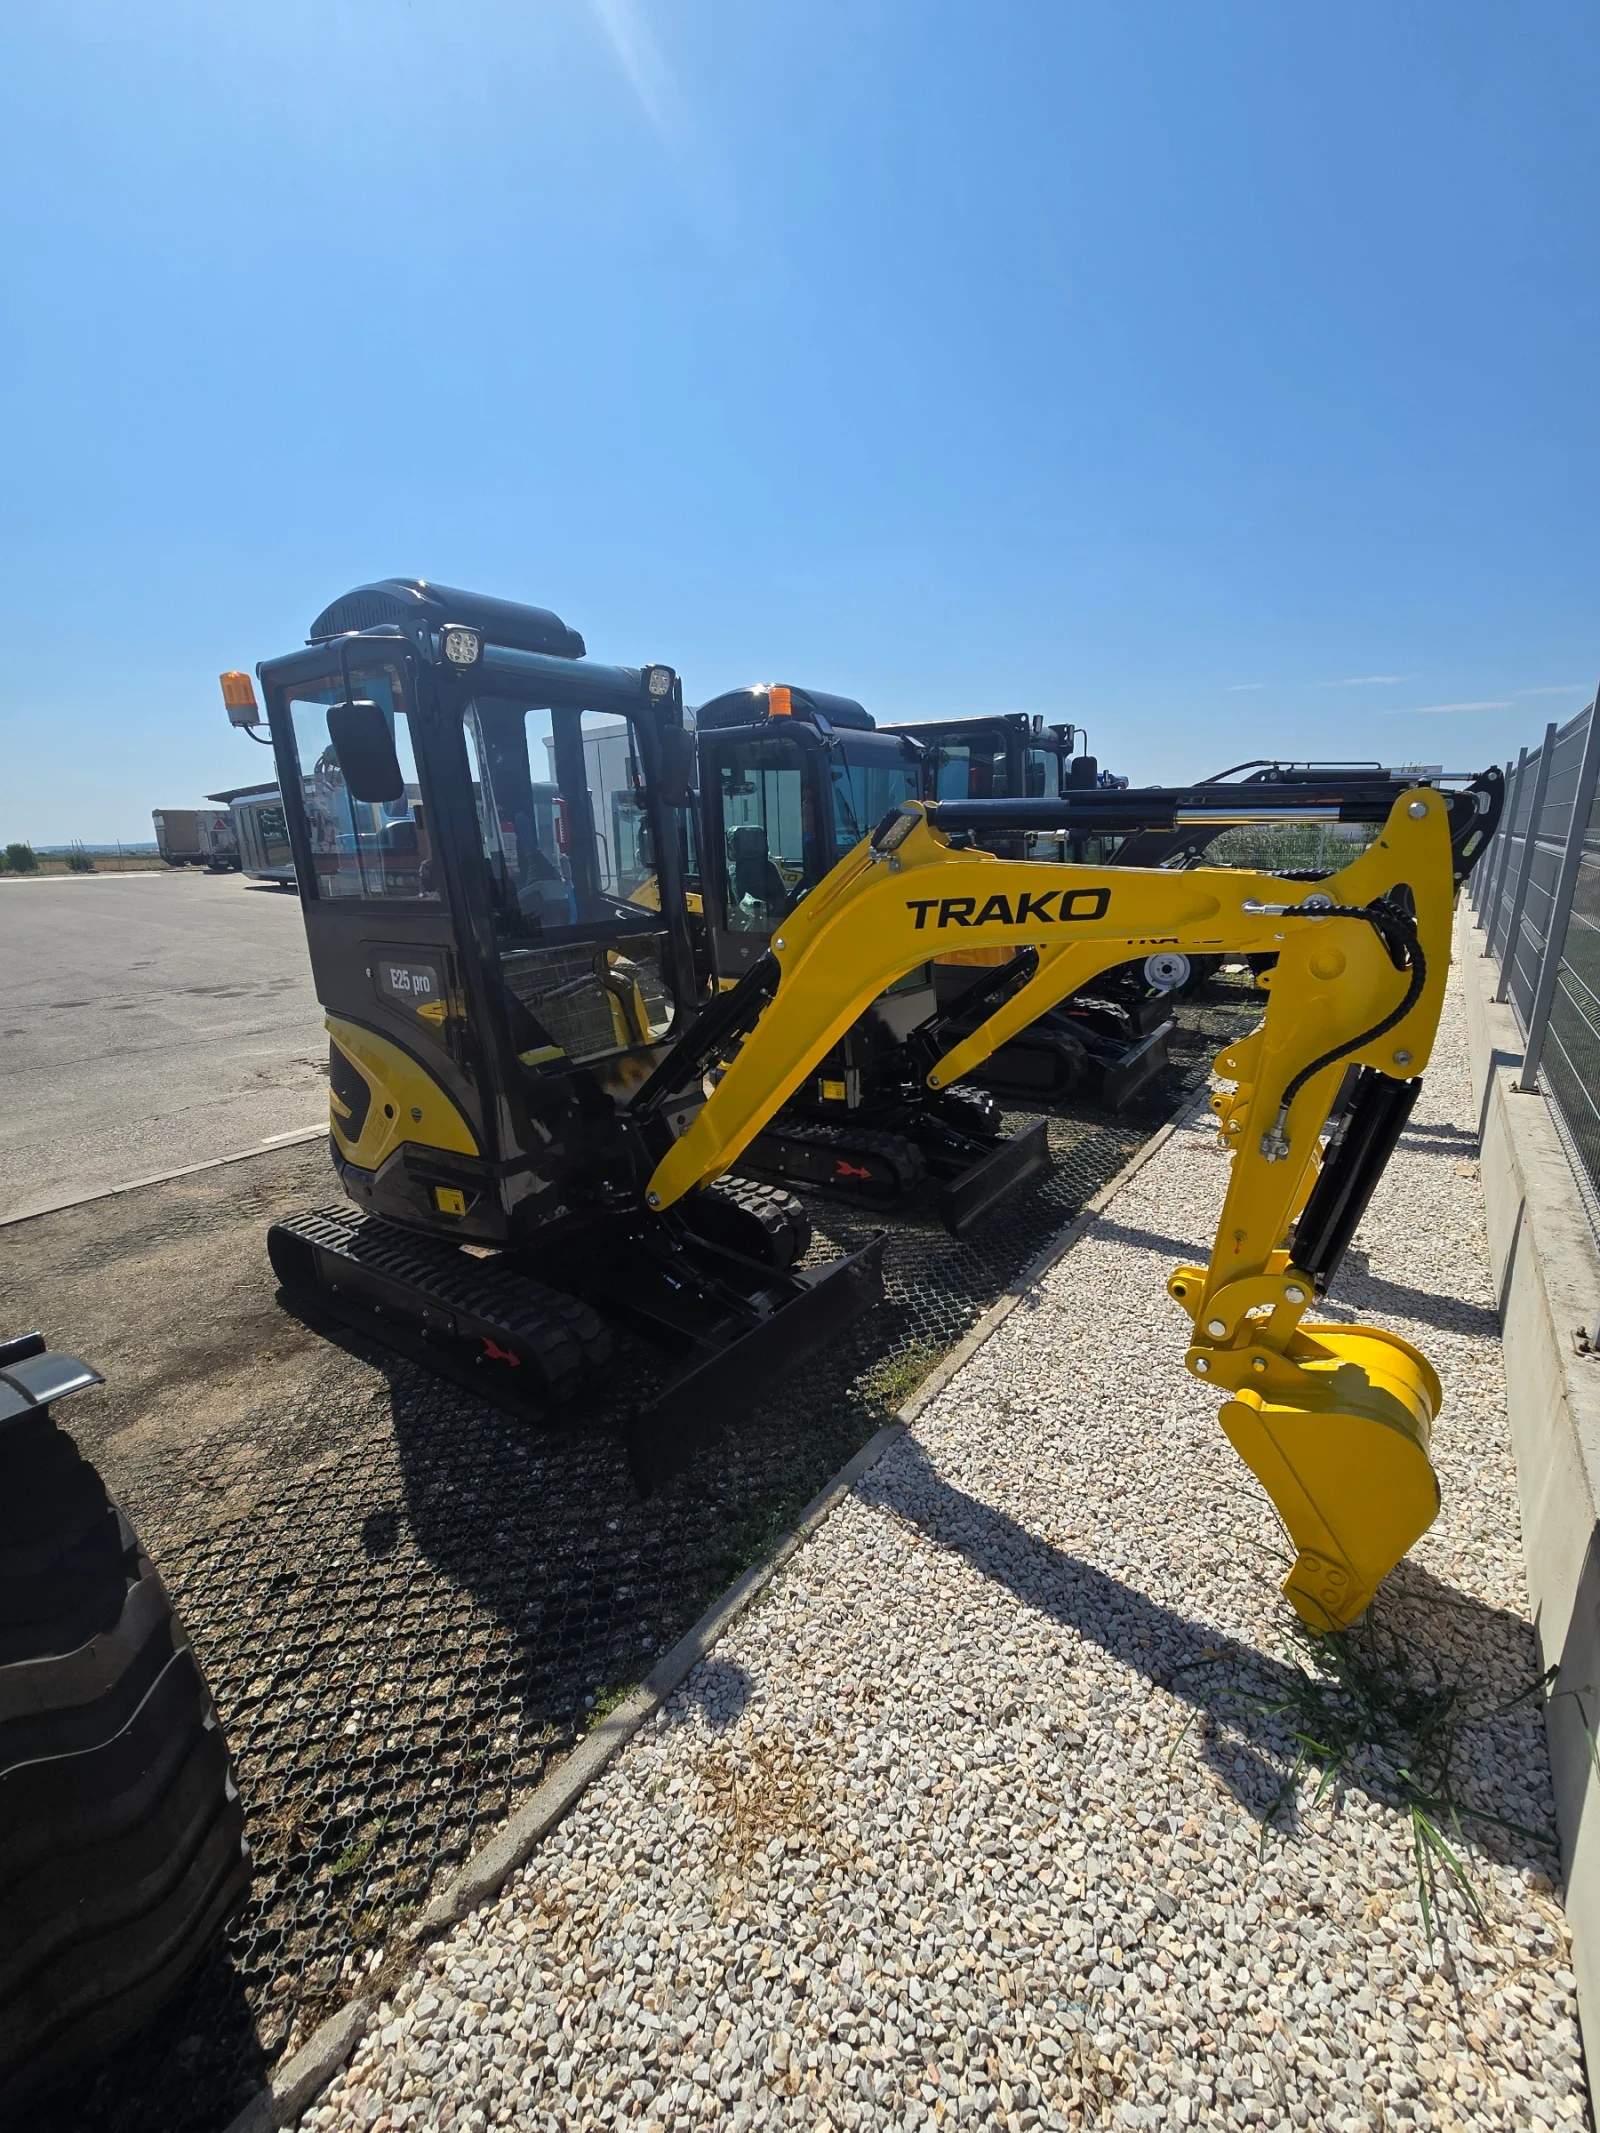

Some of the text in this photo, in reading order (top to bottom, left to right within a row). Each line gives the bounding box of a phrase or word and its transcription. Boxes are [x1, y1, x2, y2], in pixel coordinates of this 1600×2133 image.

[906, 888, 1111, 929] TRAKO
[390, 968, 430, 995] E25 pro
